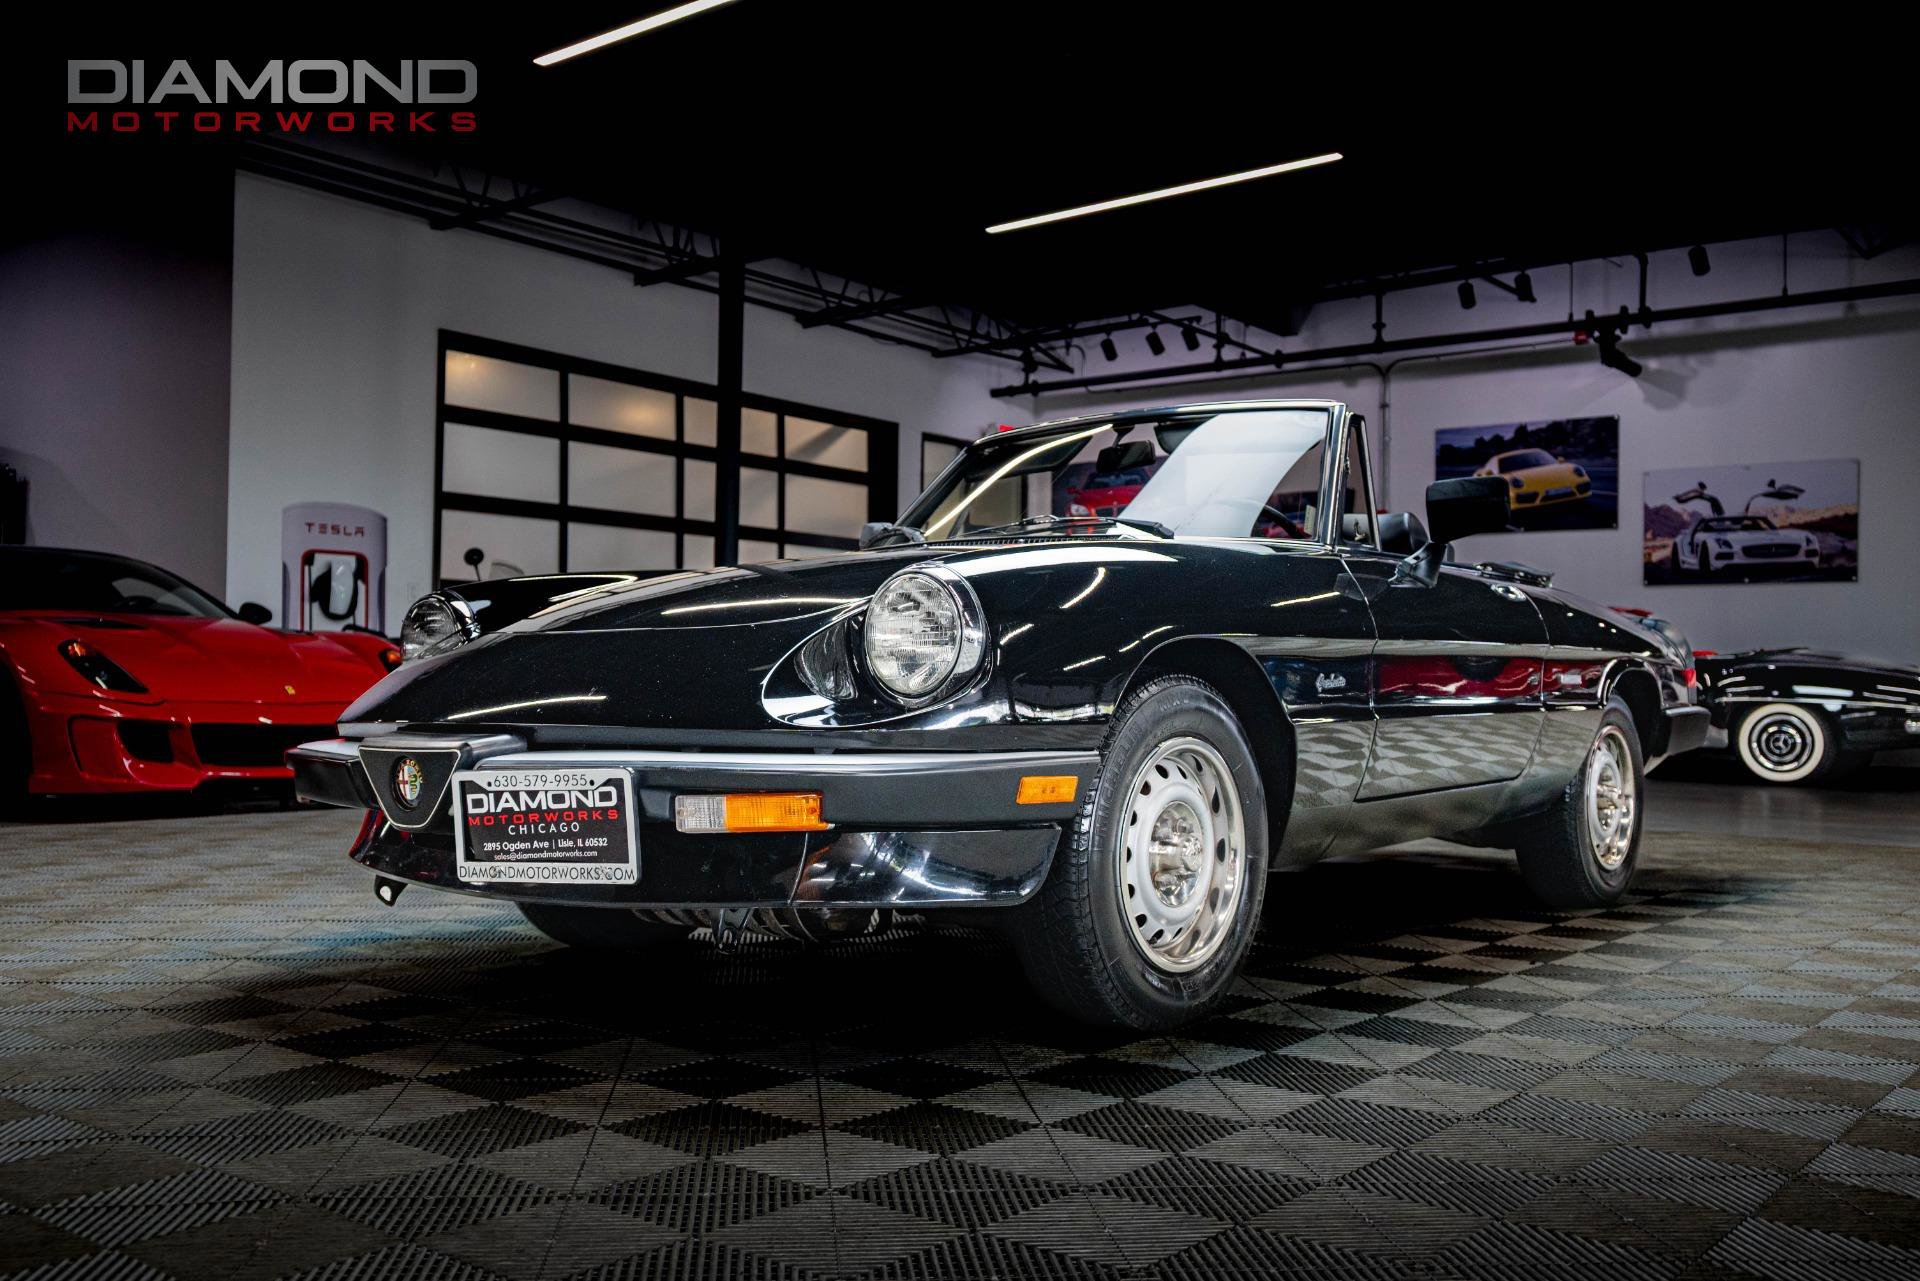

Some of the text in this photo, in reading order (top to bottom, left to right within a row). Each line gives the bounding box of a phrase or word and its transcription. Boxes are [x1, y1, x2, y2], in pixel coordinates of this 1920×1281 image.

[305, 522, 365, 538] TESLA
[493, 774, 588, 788] 630-579-9955
[466, 786, 618, 814] DIAMOND
[468, 809, 619, 827] MOTORWORKS
[508, 822, 580, 836] CHICAGO
[483, 842, 501, 851] 2895
[502, 841, 531, 852] Ogden
[533, 840, 550, 849] Ave
[577, 838, 584, 847] IL
[585, 837, 609, 847] 60532
[494, 849, 598, 861] sales@diamondmotorworks.com
[459, 866, 636, 881] DIAMONDMOTORWORKS.COM
